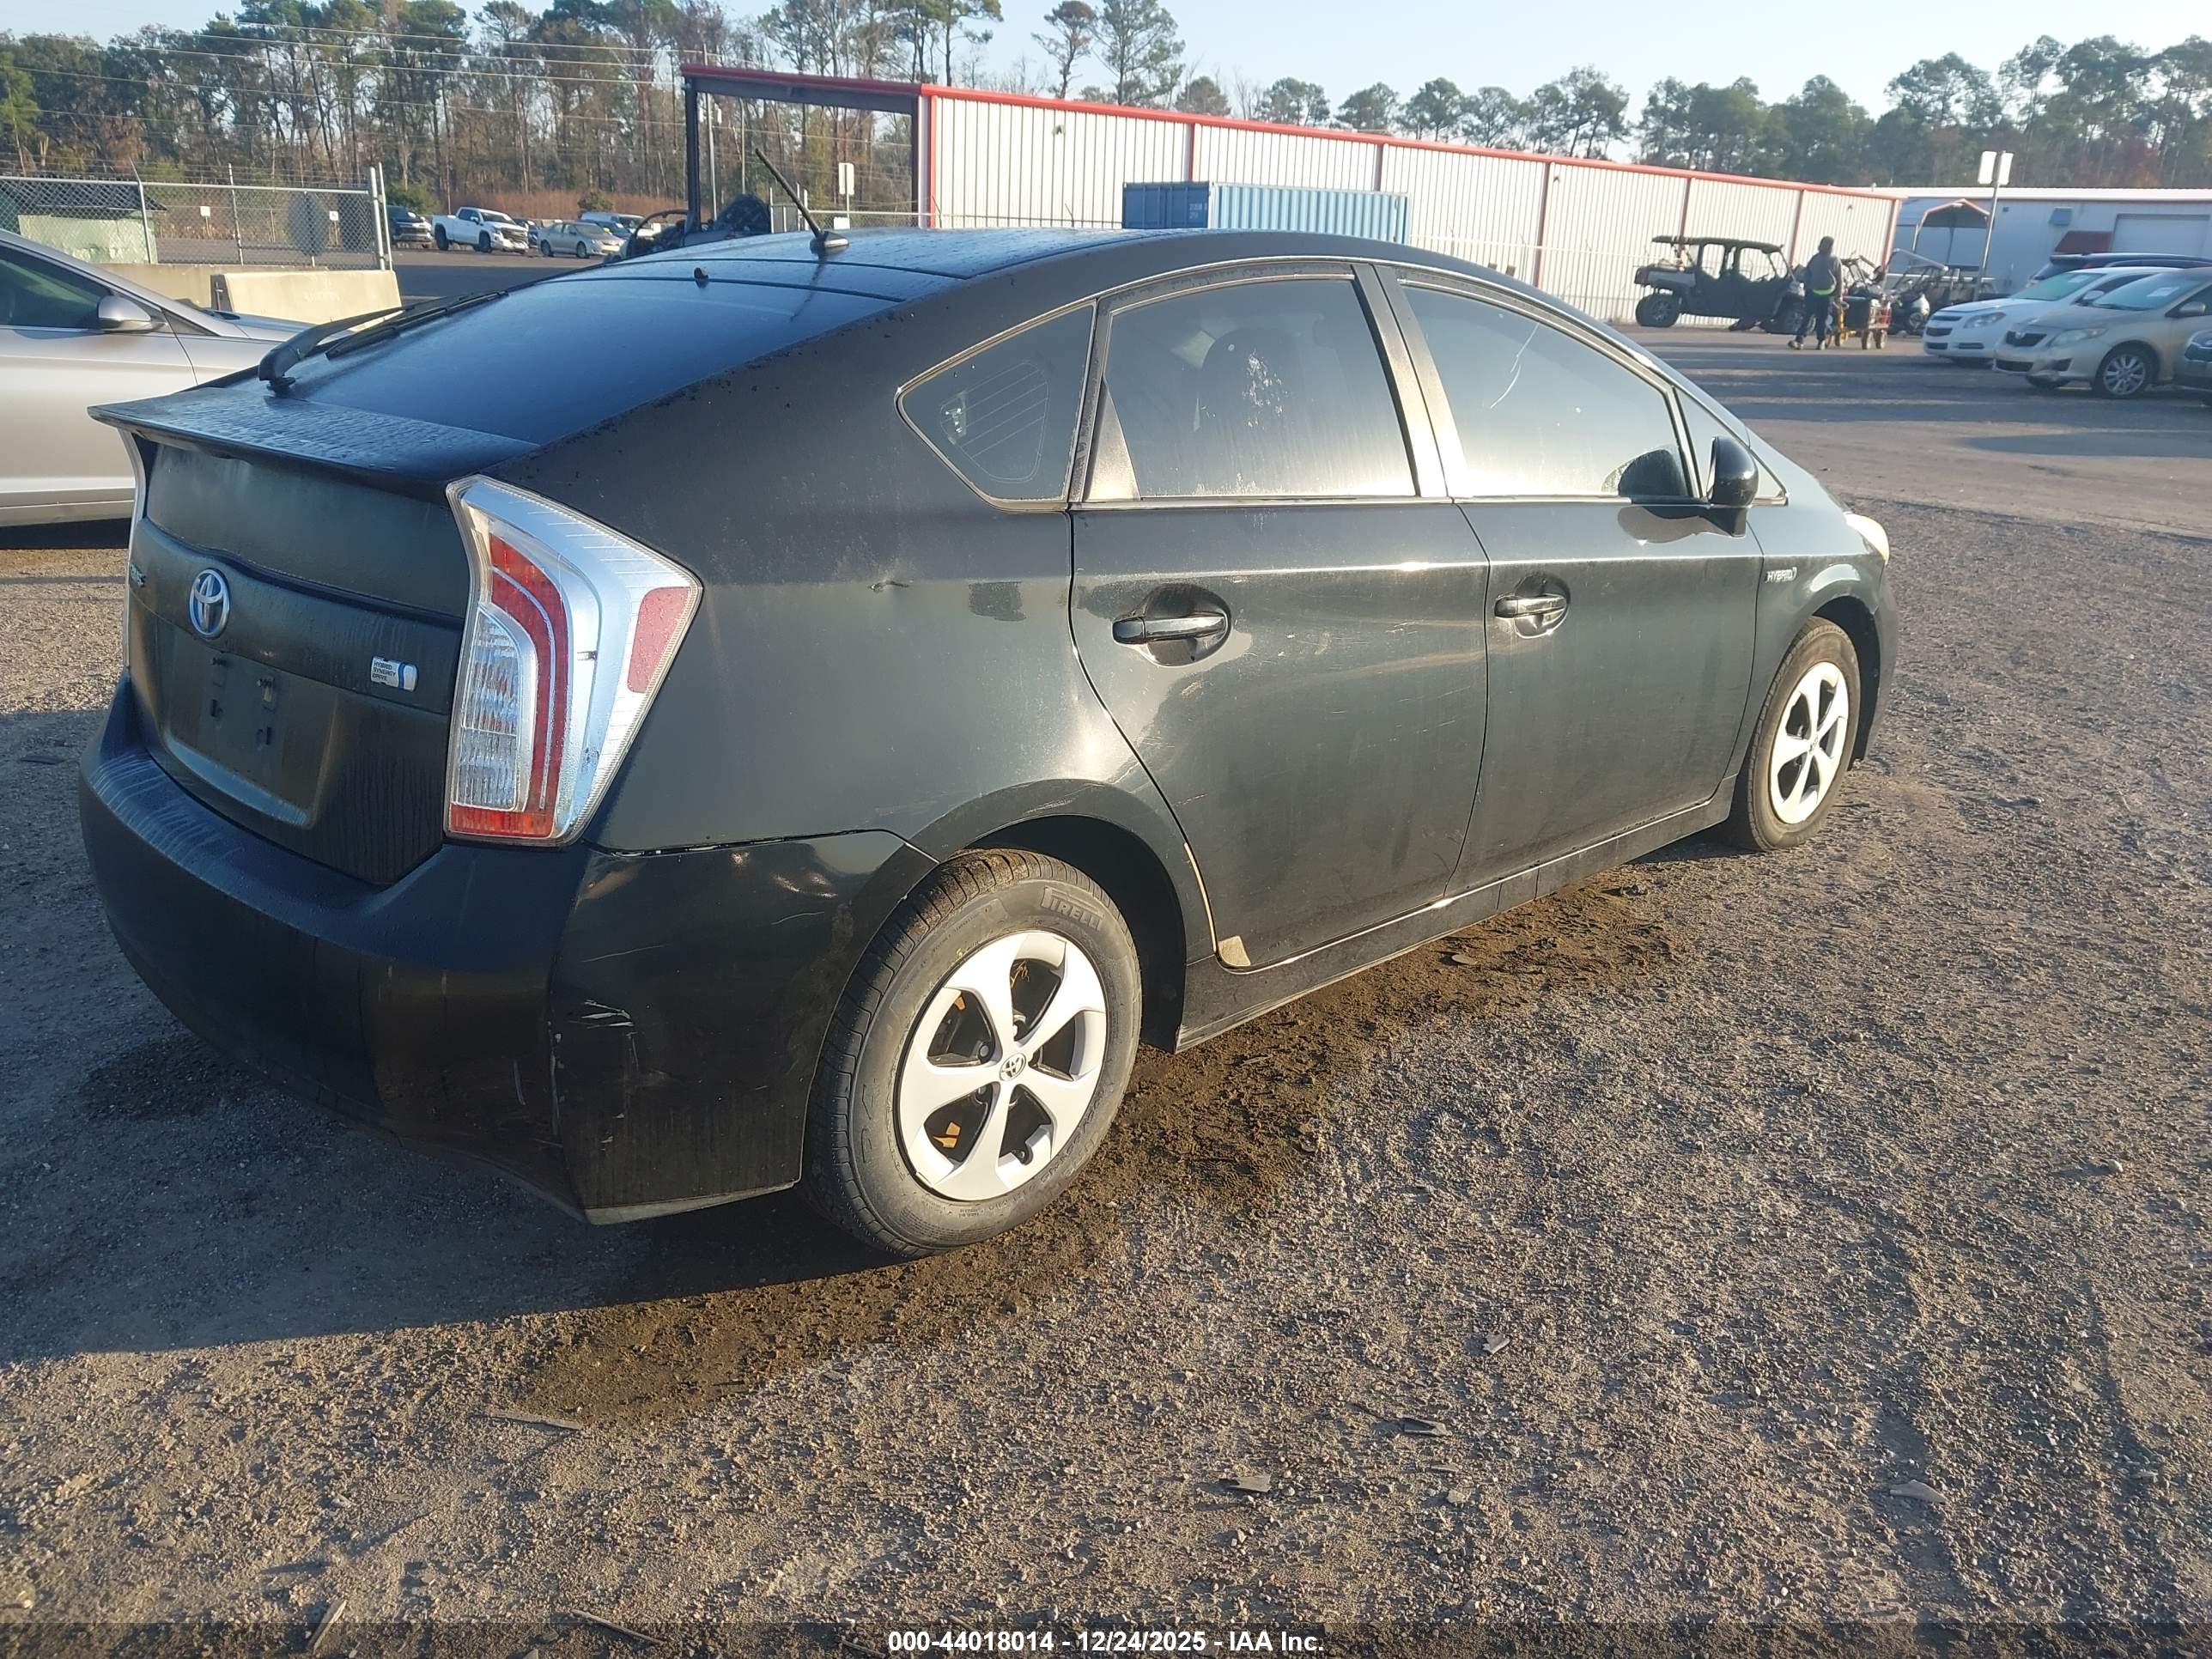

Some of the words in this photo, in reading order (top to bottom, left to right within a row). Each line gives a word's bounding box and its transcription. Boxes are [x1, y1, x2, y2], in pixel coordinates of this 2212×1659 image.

[1765, 568, 1794, 583] HYBRID
[373, 659, 392, 670] HYBRID
[372, 673, 388, 682] DRIVE
[373, 666, 396, 678] SYNERGY
[1041, 885, 1105, 931] PIRELLI
